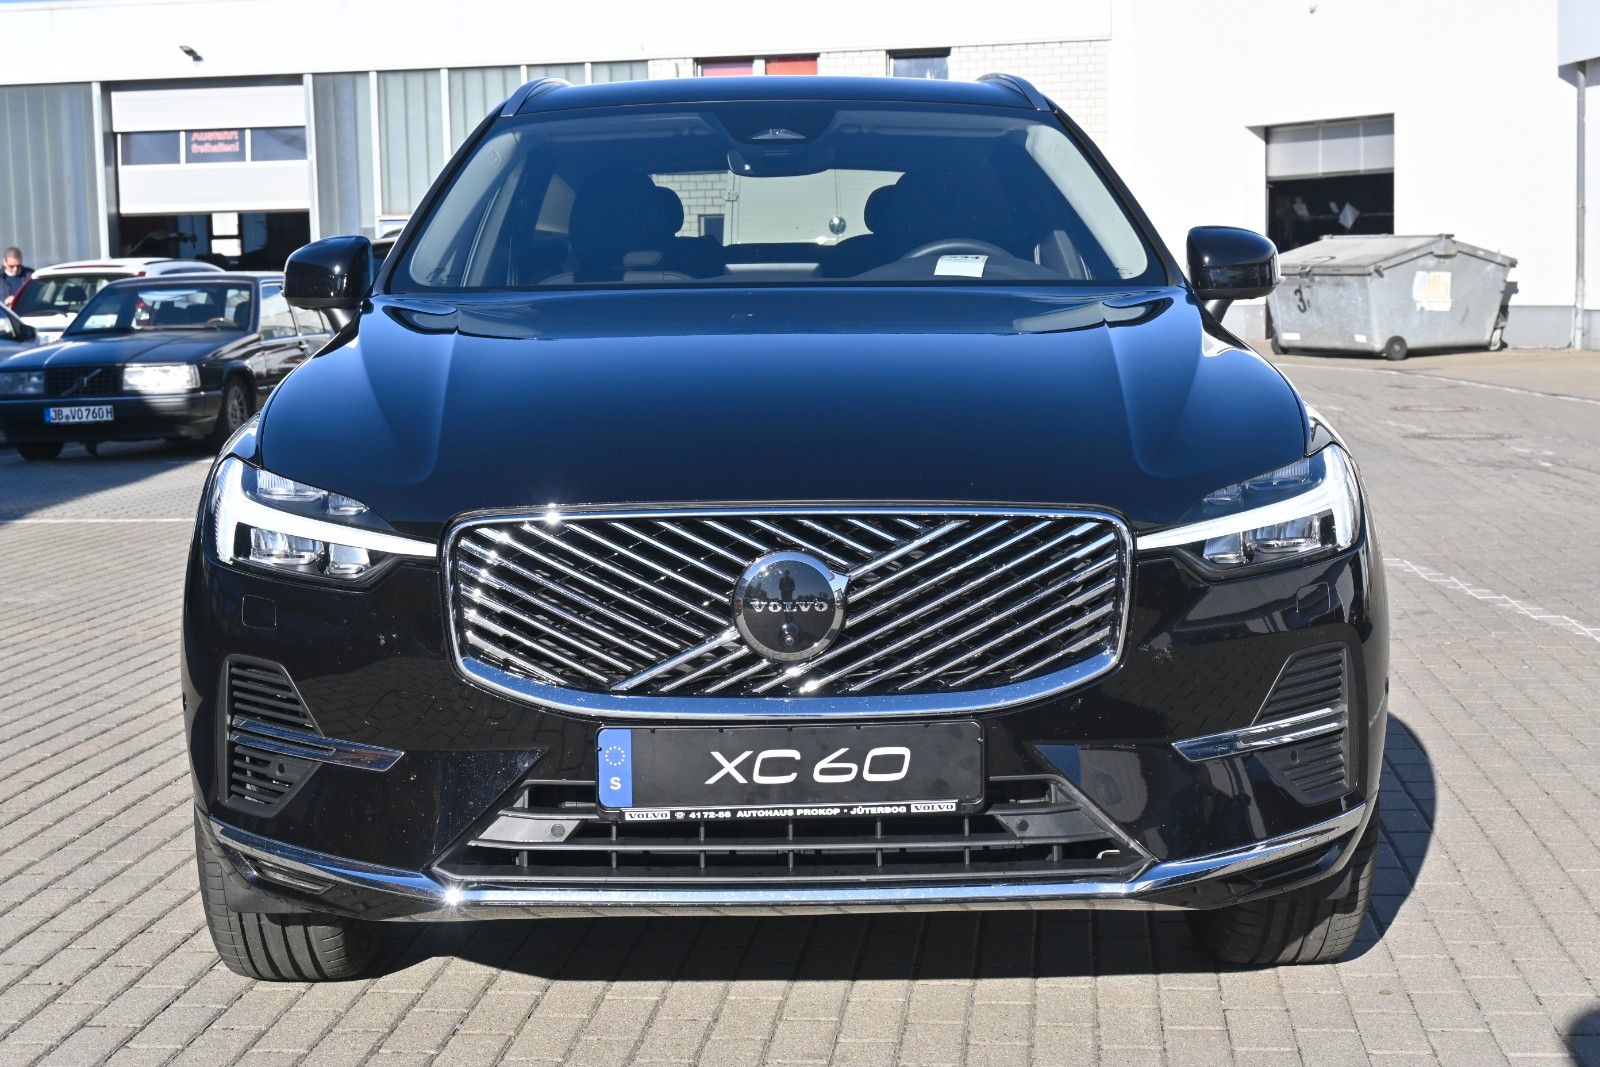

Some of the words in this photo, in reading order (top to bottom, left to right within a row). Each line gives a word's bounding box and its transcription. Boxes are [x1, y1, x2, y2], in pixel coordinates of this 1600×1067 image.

[750, 601, 829, 613] VOLVO
[704, 749, 801, 785] XC
[813, 746, 911, 783] 60
[609, 776, 622, 790] S
[736, 809, 795, 817] AUTOHAUS
[796, 808, 841, 816] PROKOP
[850, 806, 907, 815] JÜTERBOG
[914, 803, 954, 811] VOLVO
